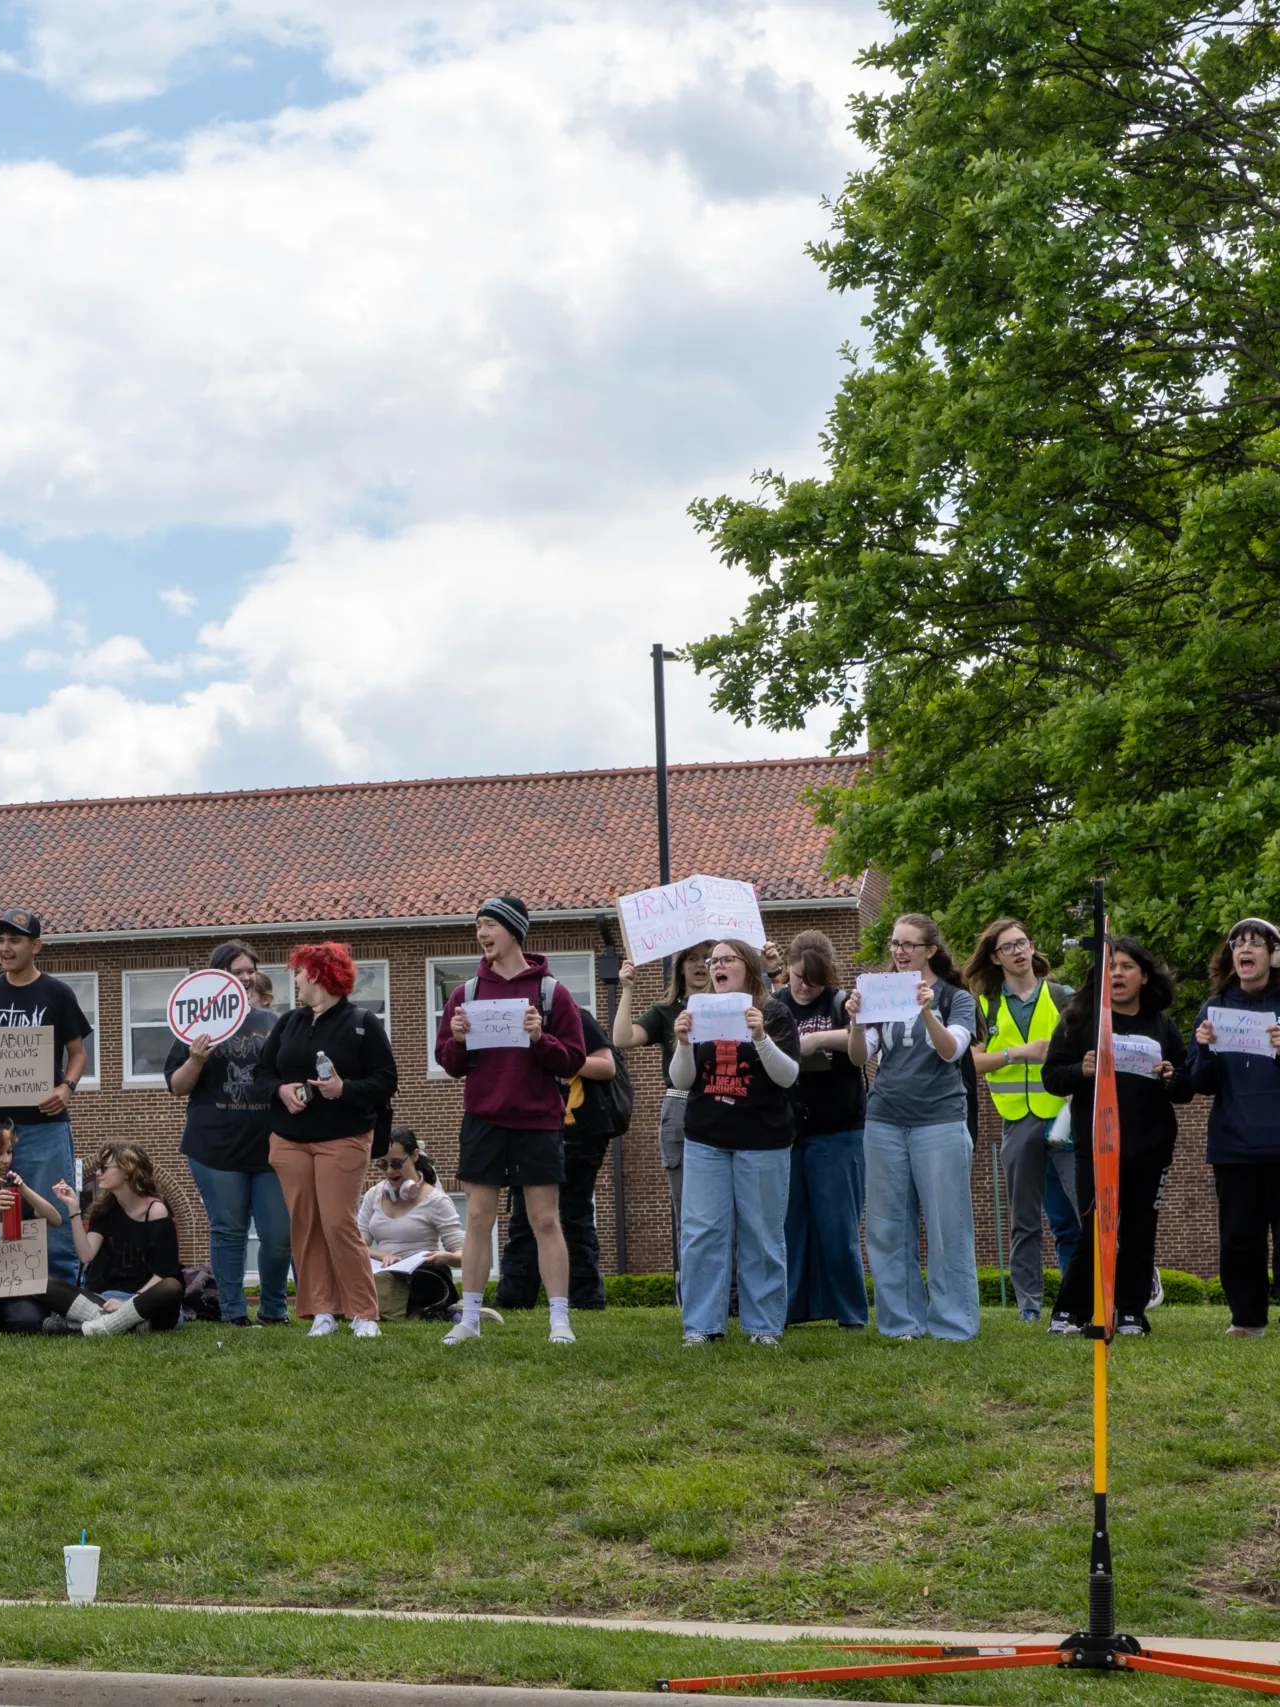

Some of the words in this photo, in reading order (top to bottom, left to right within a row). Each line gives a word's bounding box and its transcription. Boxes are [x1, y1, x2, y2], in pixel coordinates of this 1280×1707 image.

[626, 880, 703, 921] TRANS
[704, 880, 754, 904] RIGHTS
[630, 925, 680, 958] HUMAN
[685, 913, 754, 934] DECENCY
[175, 993, 240, 1025] TRUMP
[481, 1009, 513, 1021] ICE
[1237, 1015, 1261, 1027] YOU
[0, 1033, 43, 1048] ABOUT
[4, 1068, 37, 1079] ABOUT
[710, 1075, 714, 1085] I
[716, 1076, 742, 1087] MEAN
[704, 1085, 748, 1097] BUSINESS
